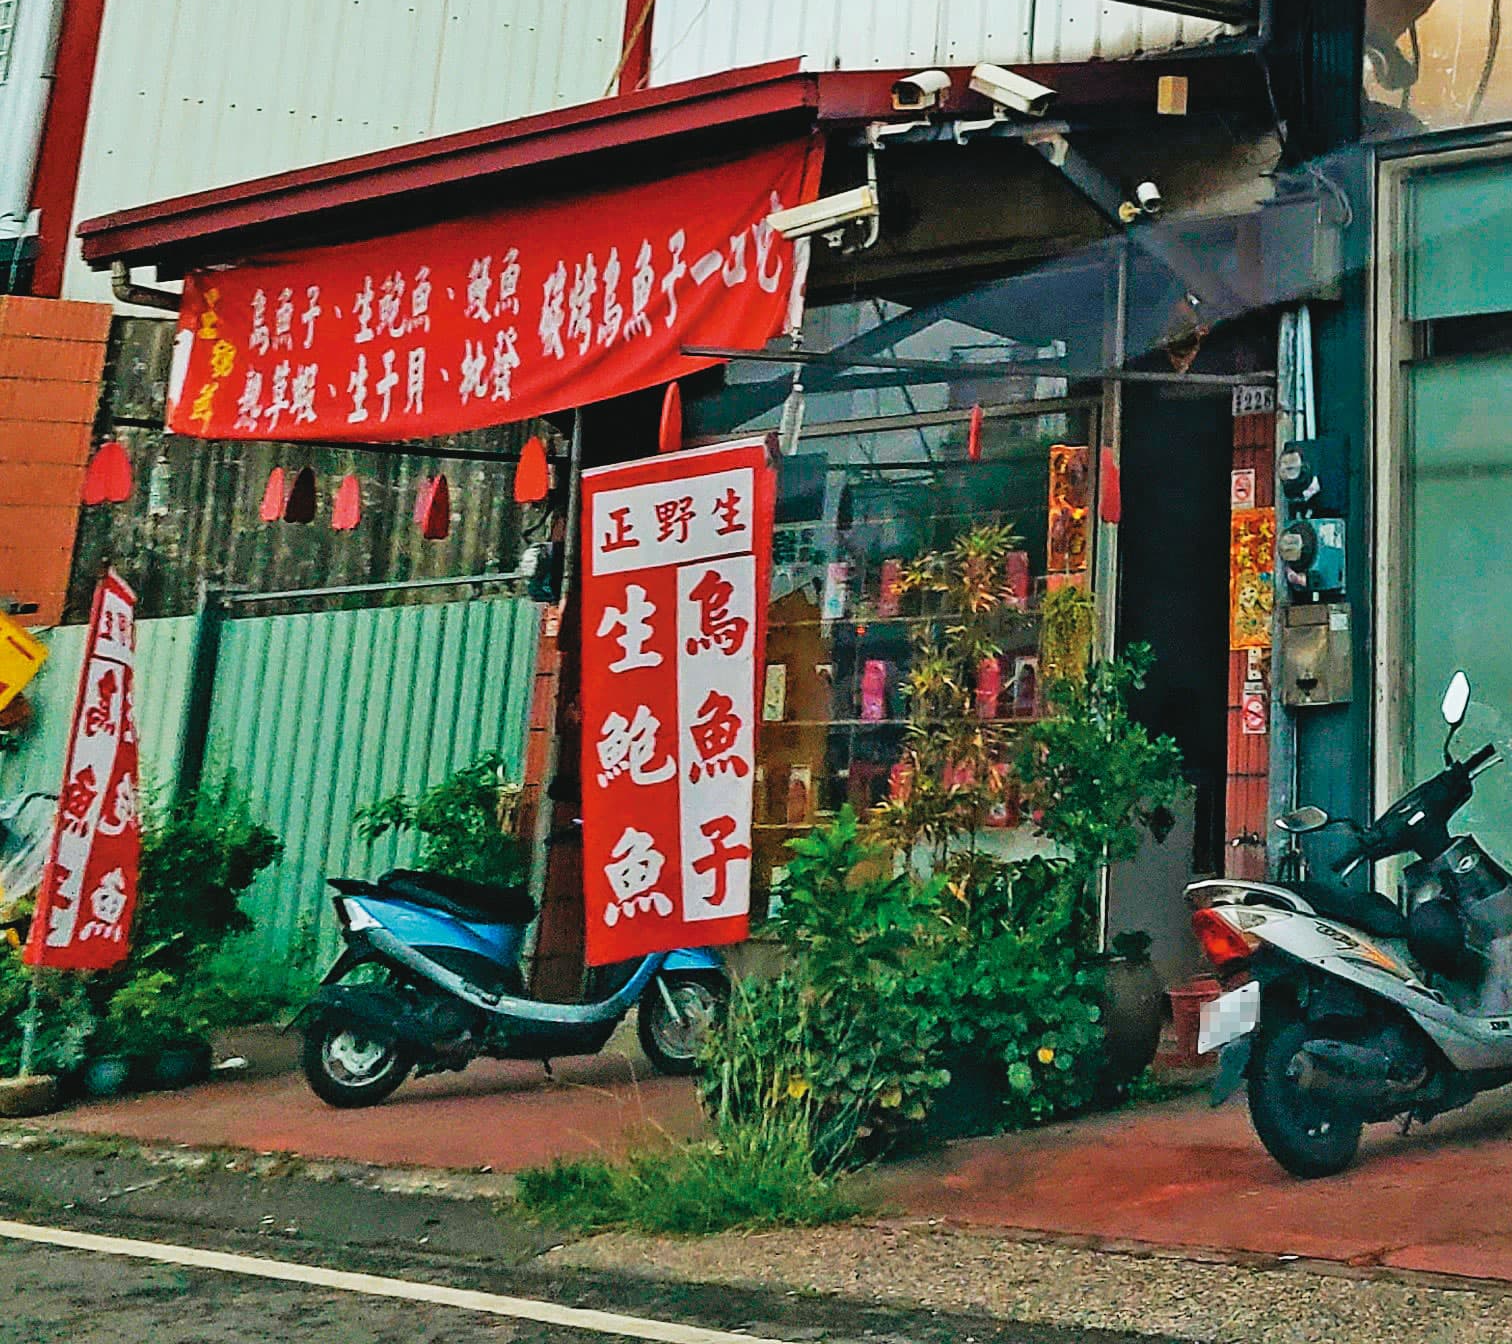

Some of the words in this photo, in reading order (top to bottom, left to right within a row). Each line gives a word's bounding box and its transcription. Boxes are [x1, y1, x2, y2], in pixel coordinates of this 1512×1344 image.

[600, 487, 747, 555] 正野生
[595, 583, 678, 928] 生鮑魚
[685, 569, 751, 908] 烏魚子
